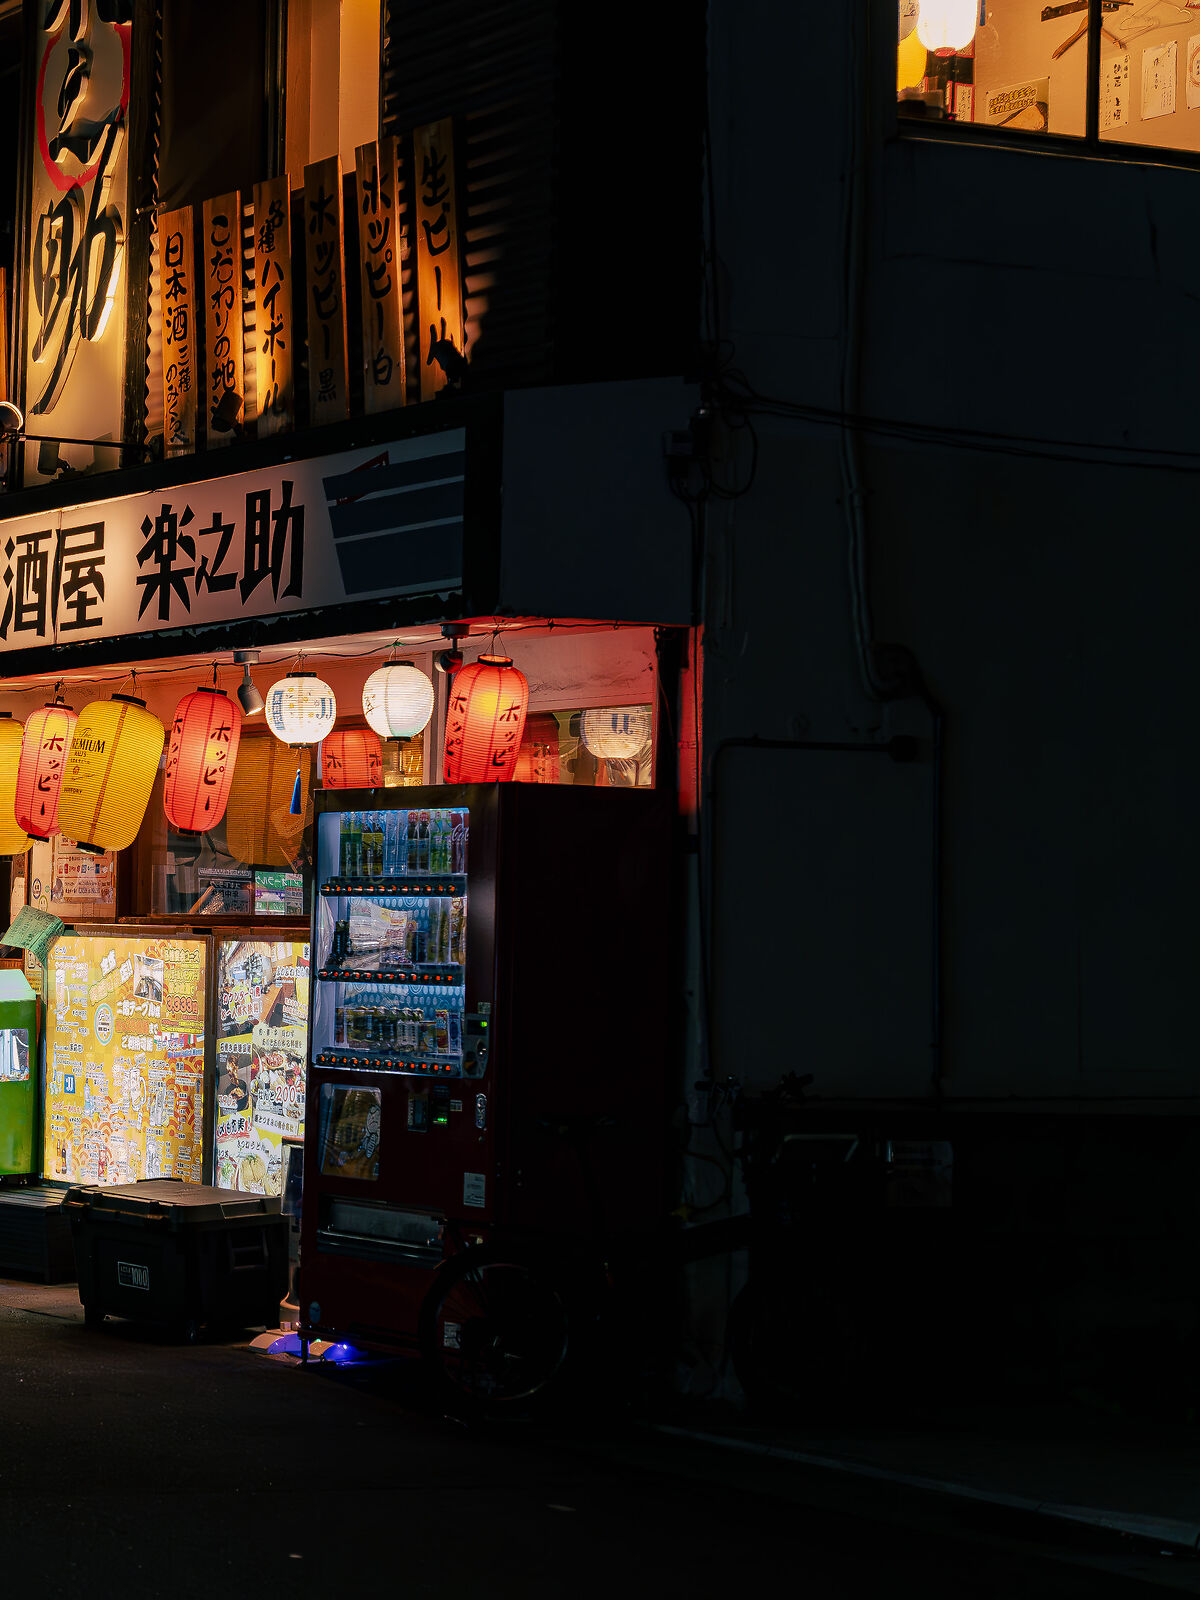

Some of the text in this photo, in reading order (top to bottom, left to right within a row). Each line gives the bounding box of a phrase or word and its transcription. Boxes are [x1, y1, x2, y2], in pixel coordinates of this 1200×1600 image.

[165, 231, 188, 346] 日本酒
[210, 215, 237, 430] こだわりの地
[135, 479, 307, 624] 楽之助
[38, 733, 65, 816] ホッピー
[204, 720, 232, 811] ホッピー
